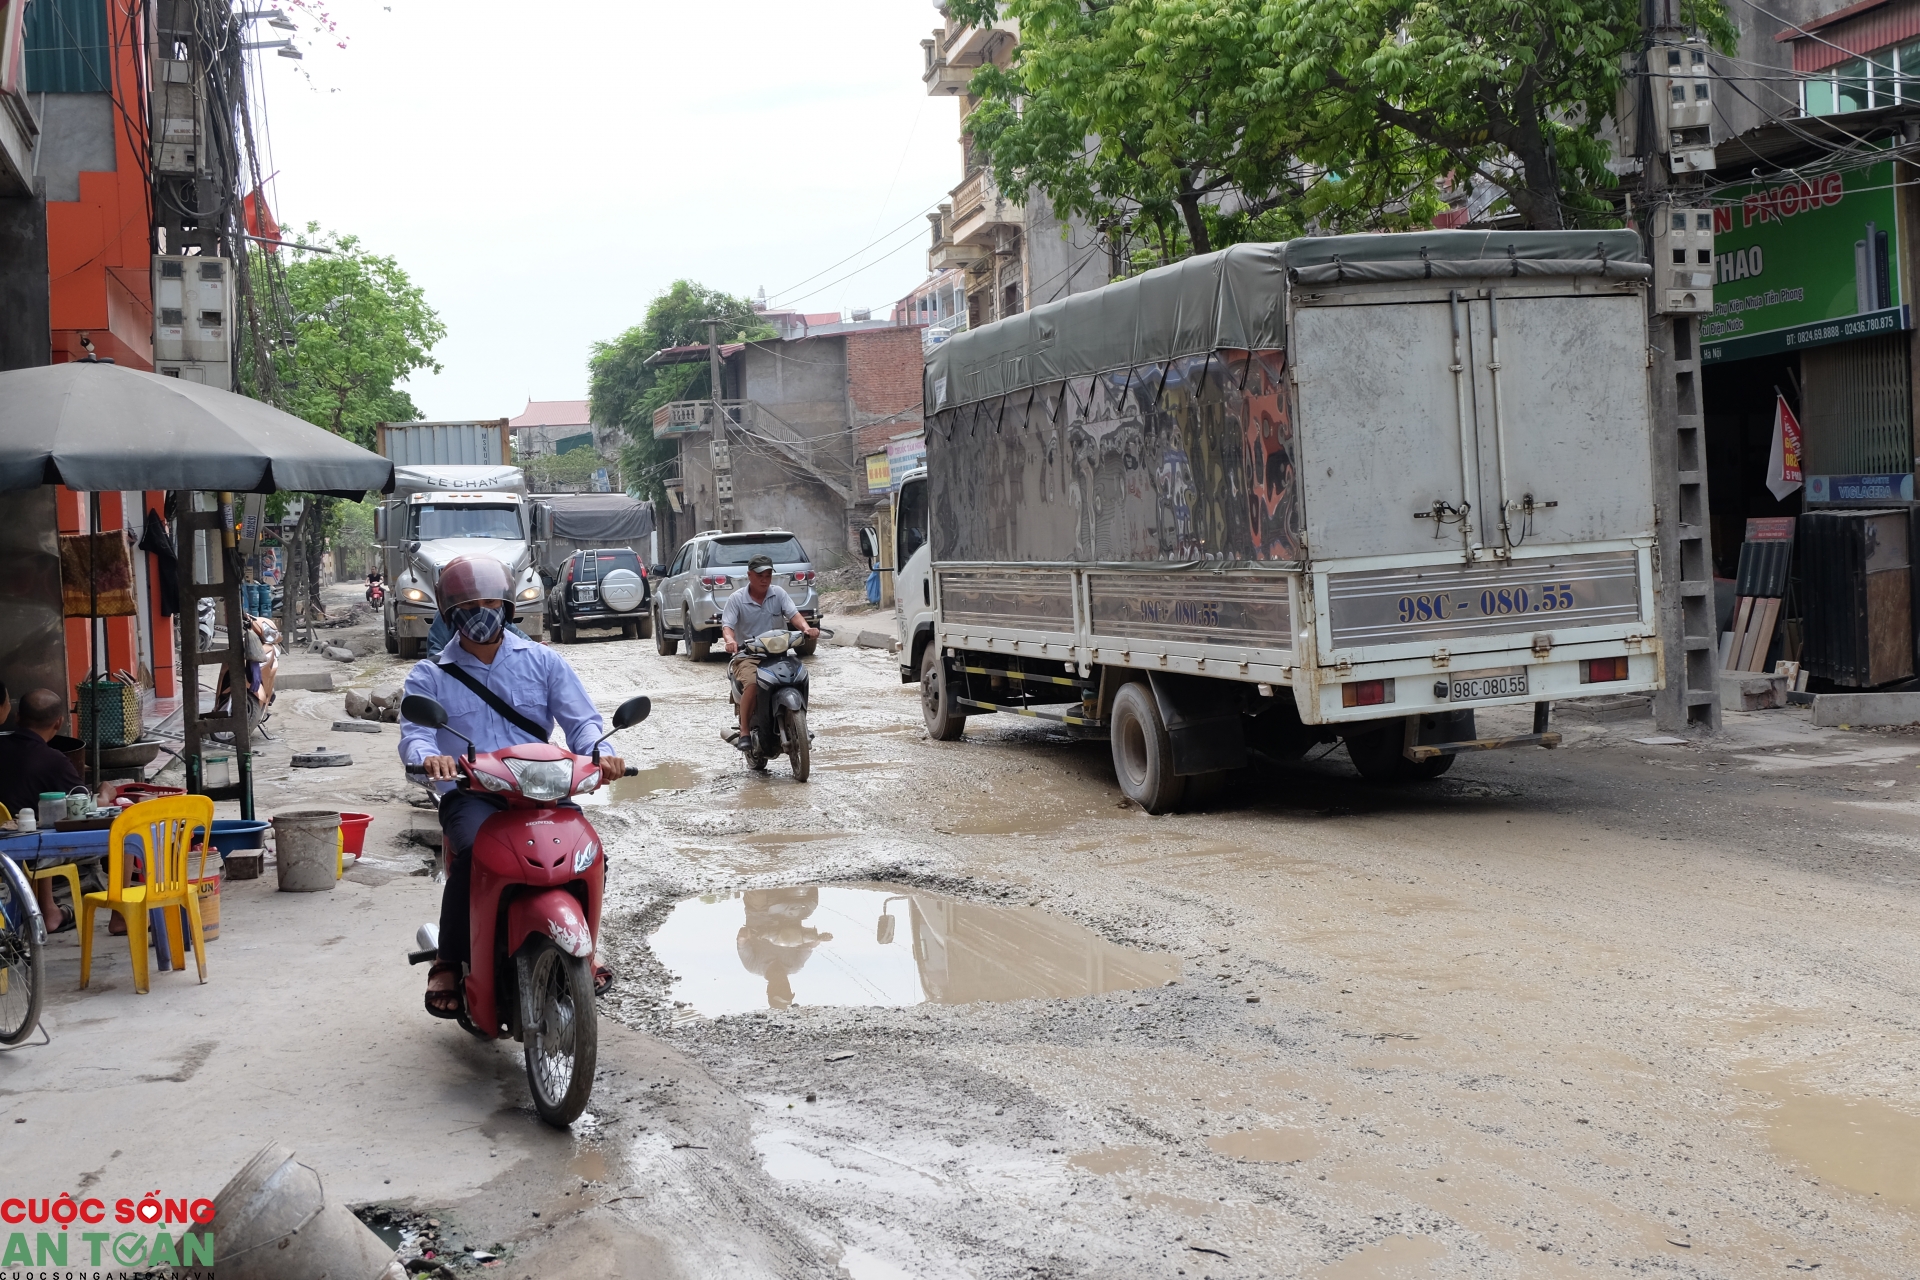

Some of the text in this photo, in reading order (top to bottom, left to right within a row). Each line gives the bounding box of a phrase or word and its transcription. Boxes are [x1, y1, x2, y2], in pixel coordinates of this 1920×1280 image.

[1743, 171, 1843, 228] PHONG
[1729, 299, 1744, 314] Kiện
[1781, 287, 1803, 302] Phong
[1797, 325, 1840, 343] 0824.69.8888
[1844, 316, 1894, 335] 02436.780.875
[453, 477, 500, 488] CHAN
[1838, 485, 1892, 499] VIGLACERA
[1398, 592, 1452, 623] 98C
[1480, 584, 1574, 616] 080.55
[1453, 676, 1527, 698] 98C-080.55
